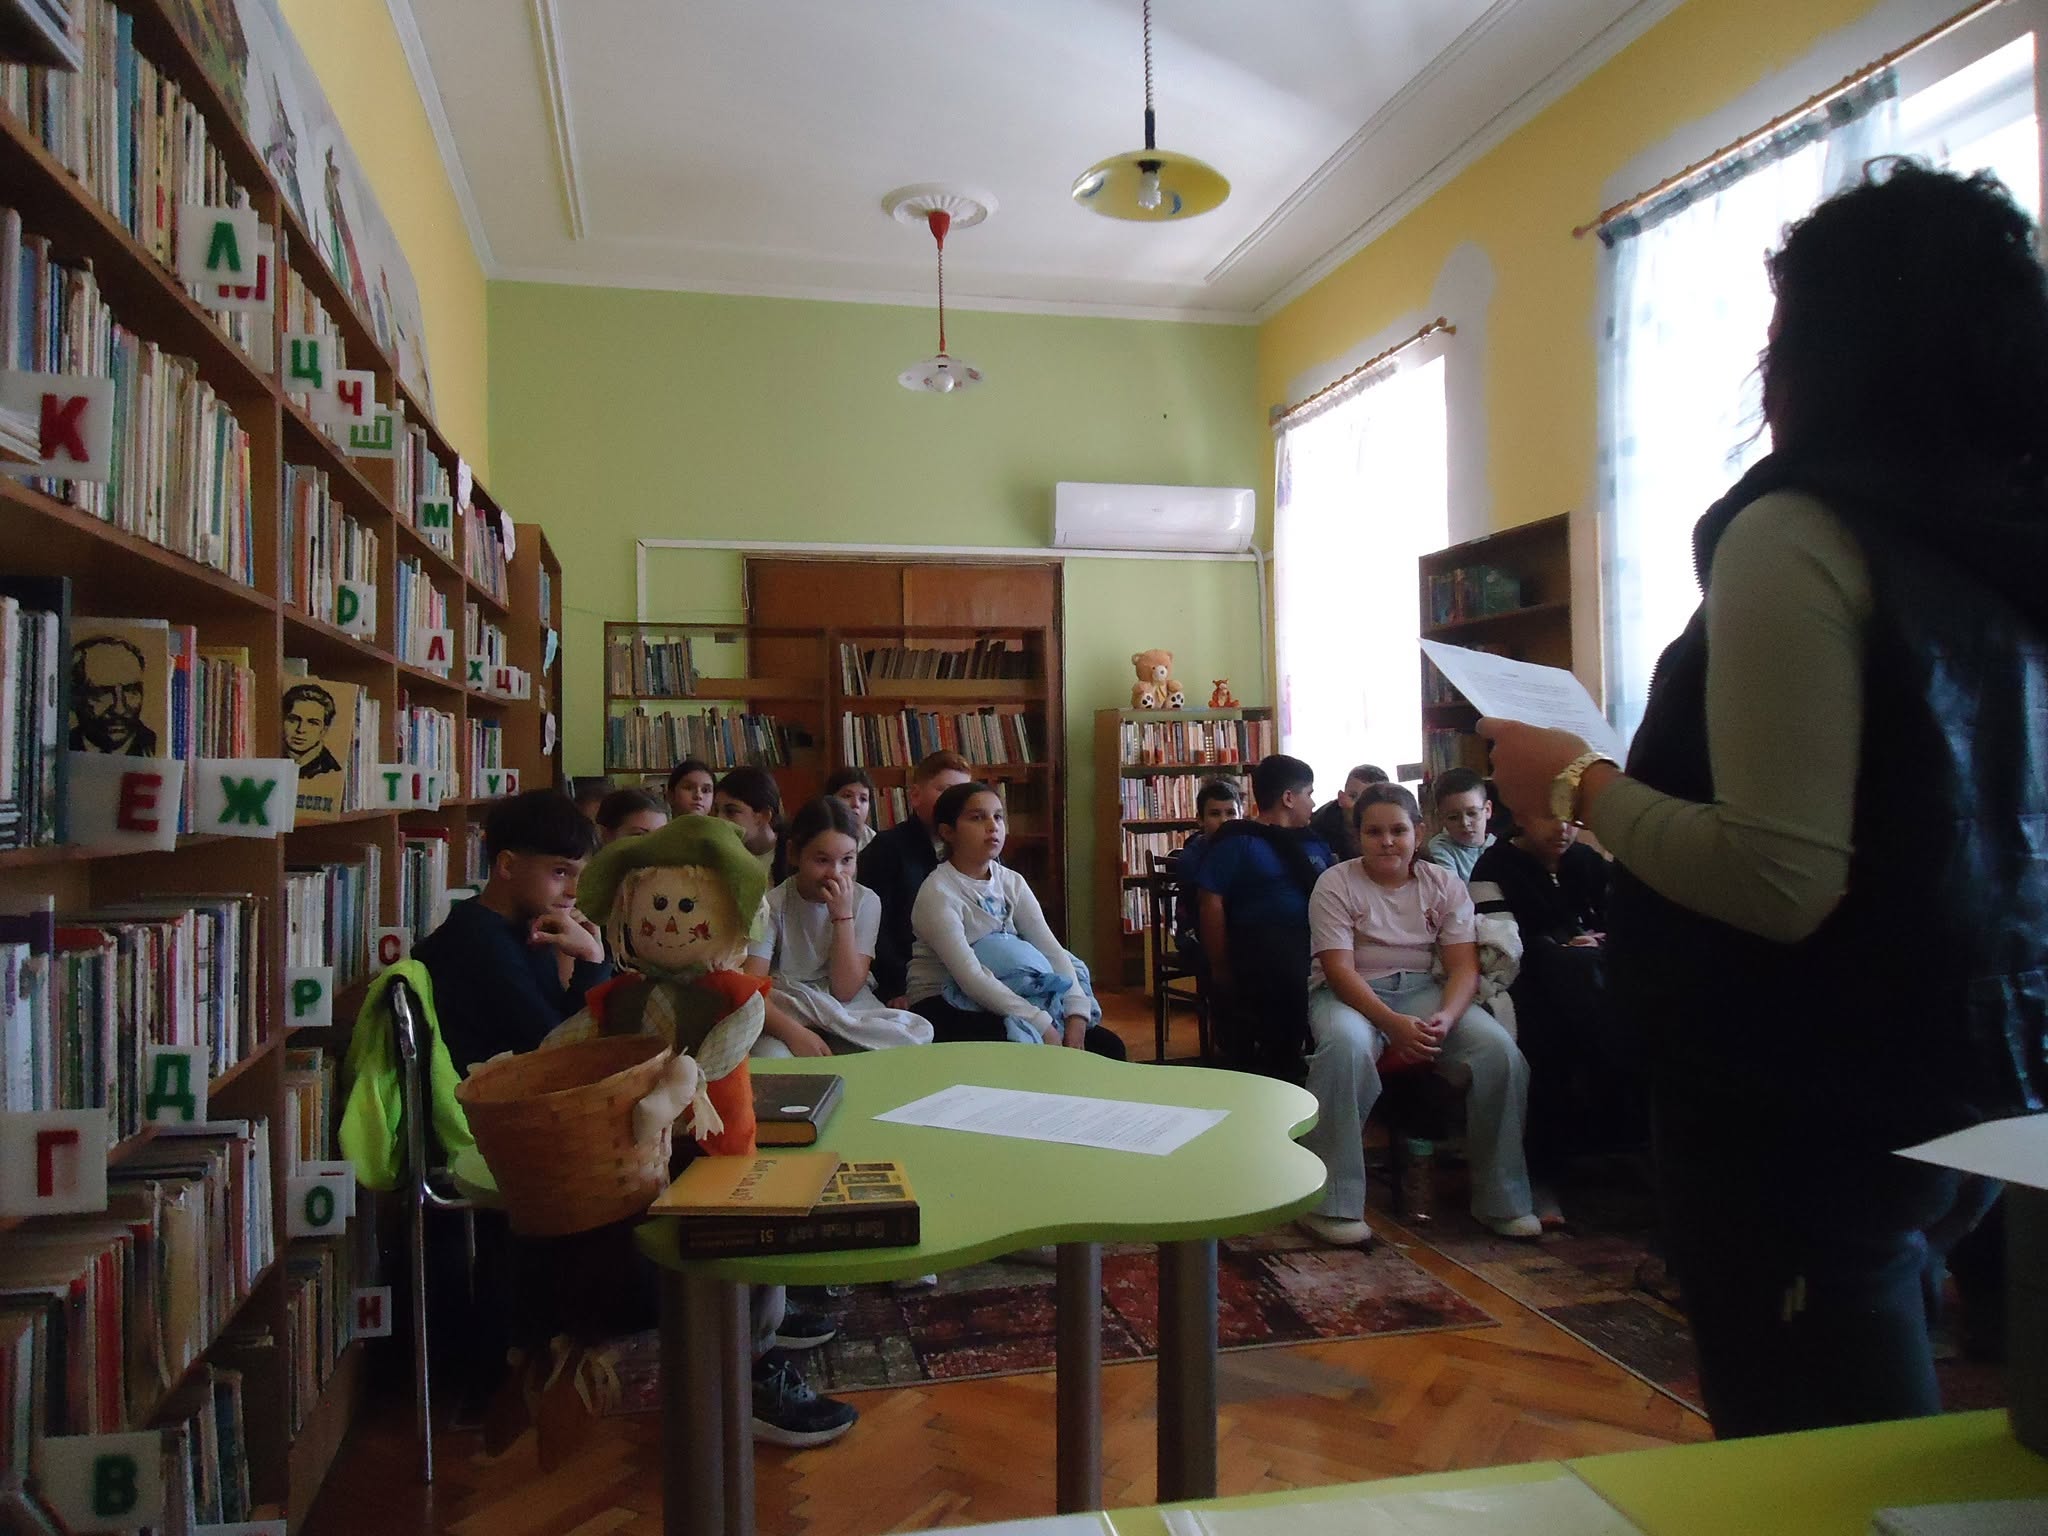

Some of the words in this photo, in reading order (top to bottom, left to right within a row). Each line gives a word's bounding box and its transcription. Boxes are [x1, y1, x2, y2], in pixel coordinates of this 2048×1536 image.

[207, 221, 241, 271] Л
[291, 339, 322, 389] Ц
[338, 380, 363, 416] Ч
[40, 394, 89, 462] К
[424, 503, 449, 528] М
[468, 660, 484, 682] Х
[118, 772, 162, 832] Е
[218, 775, 277, 826] Ж
[382, 772, 402, 801] Т
[379, 934, 400, 964] С
[292, 979, 323, 1017] Р
[146, 1053, 196, 1121] Д
[37, 1129, 79, 1198] Г
[305, 1185, 335, 1227] О
[358, 1295, 382, 1330] Н
[92, 1453, 137, 1517] В
